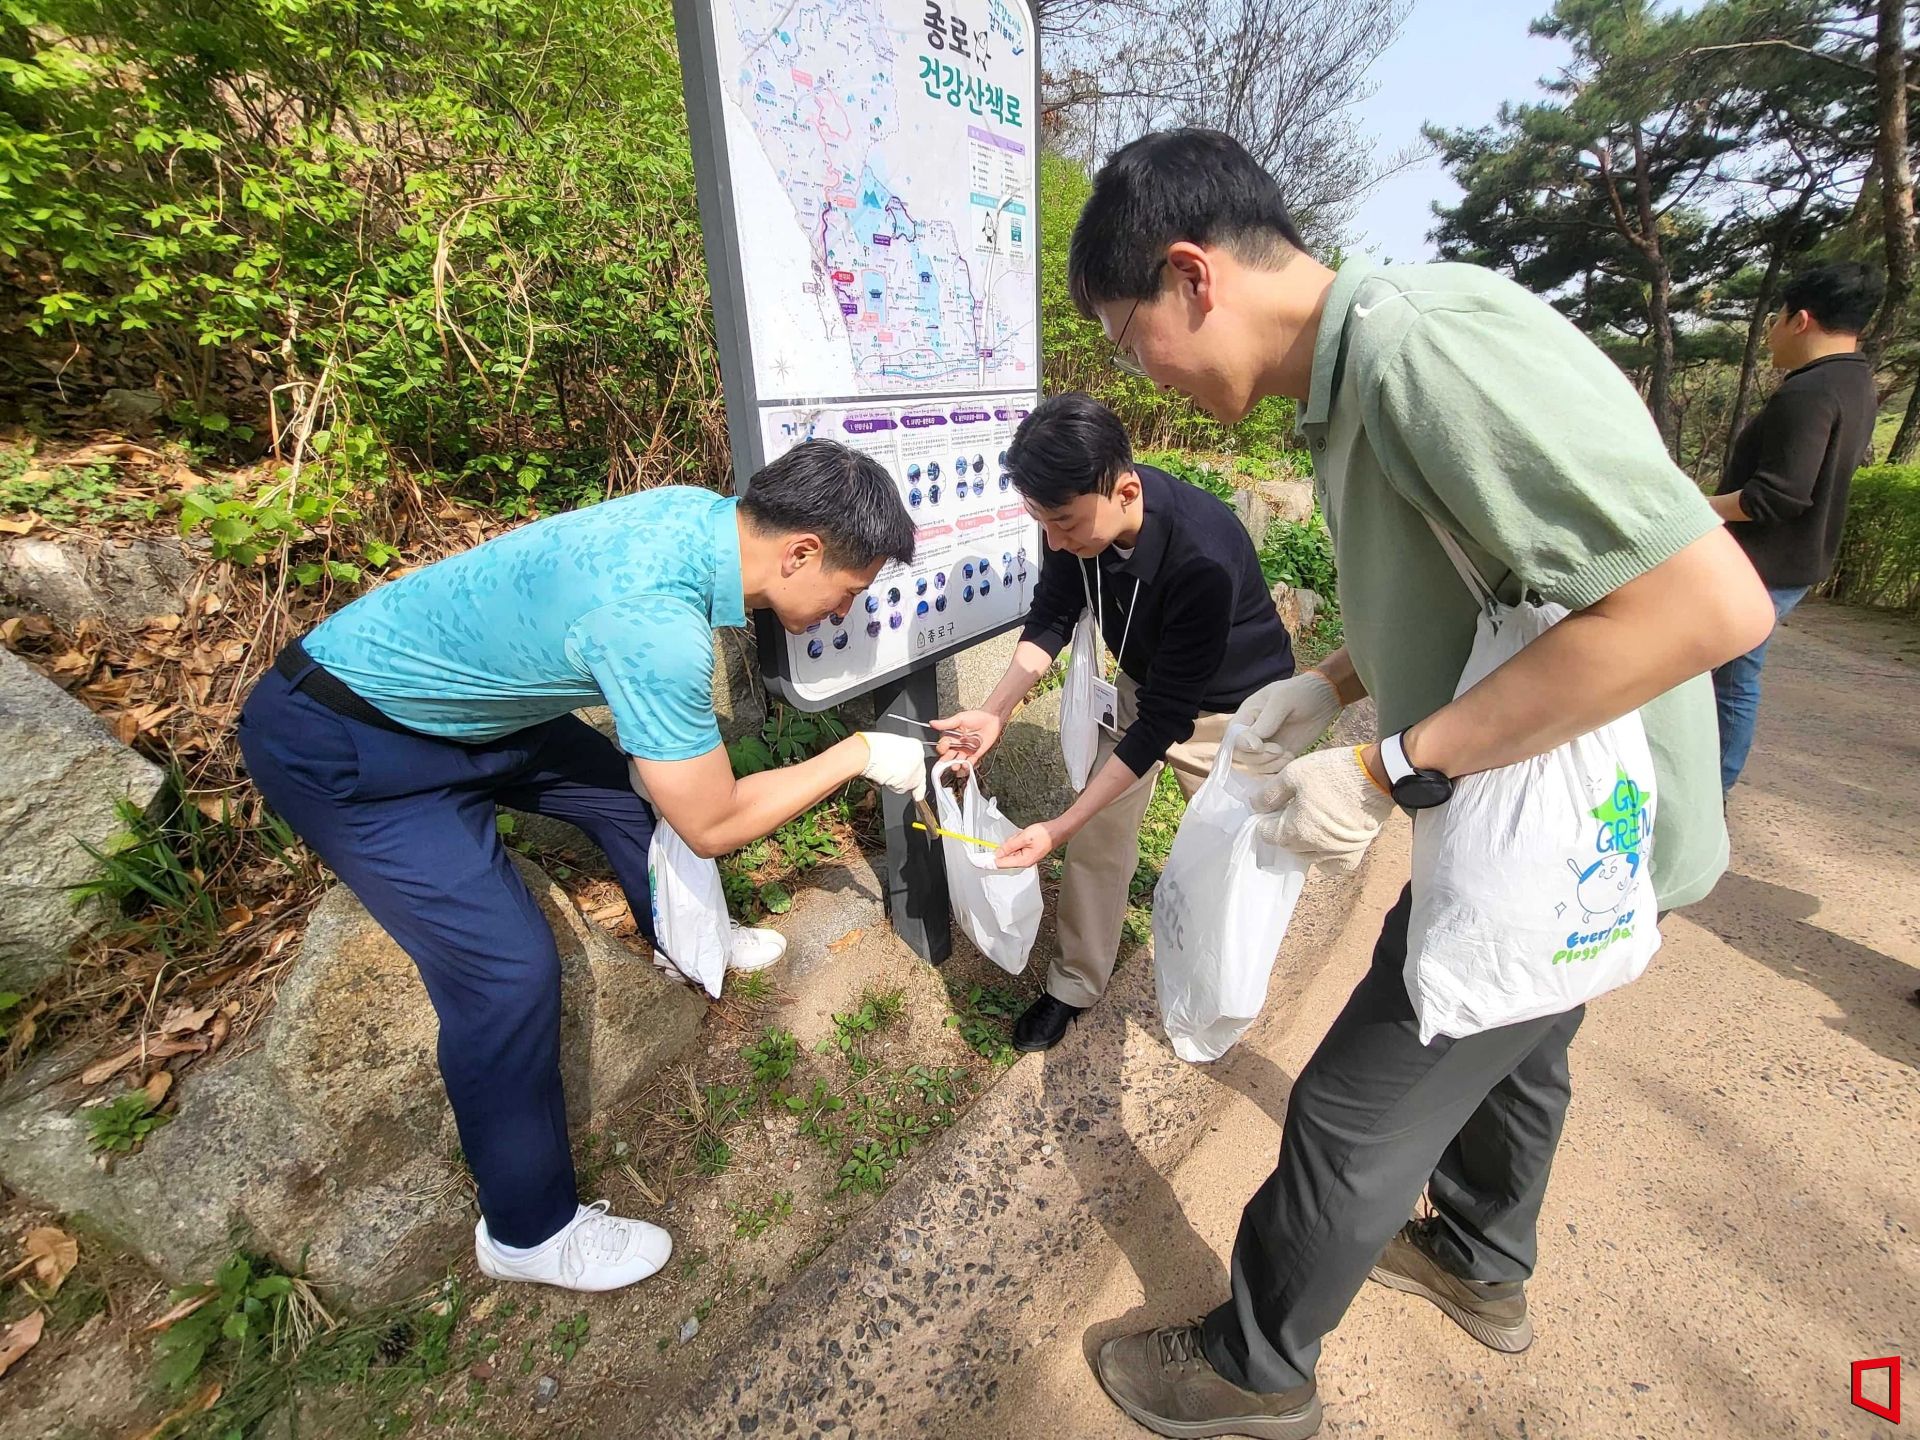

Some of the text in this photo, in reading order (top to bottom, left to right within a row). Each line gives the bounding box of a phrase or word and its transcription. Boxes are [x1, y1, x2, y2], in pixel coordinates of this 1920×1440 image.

[923, 0, 971, 58] 종로
[919, 55, 1023, 128] 건강산책로
[927, 621, 954, 643] 종로구
[1614, 779, 1639, 812] GO
[1566, 908, 1635, 948] Everyay
